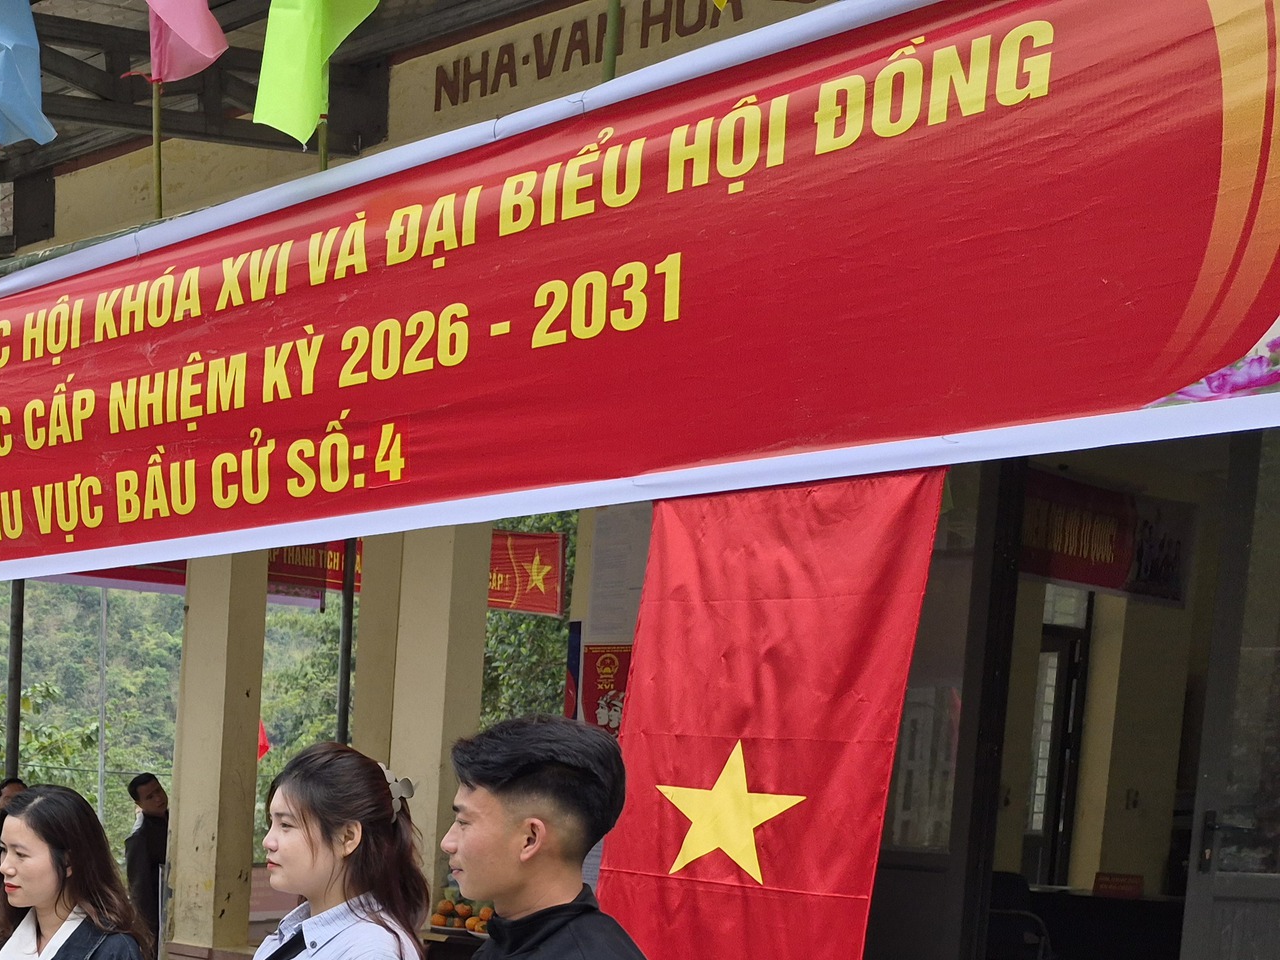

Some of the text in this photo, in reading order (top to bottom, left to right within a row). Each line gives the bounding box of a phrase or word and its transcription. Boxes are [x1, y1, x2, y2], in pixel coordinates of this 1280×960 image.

[22, 294, 85, 366] HỘI
[94, 265, 202, 343] KHÓA
[215, 239, 294, 312] XVI
[308, 210, 368, 287] VÀ
[385, 184, 484, 270] ĐẠI
[498, 126, 647, 238] BIỂU
[666, 93, 790, 195] HỘI
[813, 20, 1055, 156] ĐỒNG
[23, 372, 96, 451] CẤP
[108, 351, 247, 435] NHIỆM
[262, 323, 325, 404] KỲ
[338, 301, 470, 389] 2026
[489, 320, 511, 338] -
[531, 251, 683, 350] 2031
[31, 473, 104, 544] VỰC
[116, 445, 197, 524] BẦU
[210, 427, 276, 510] CỬ
